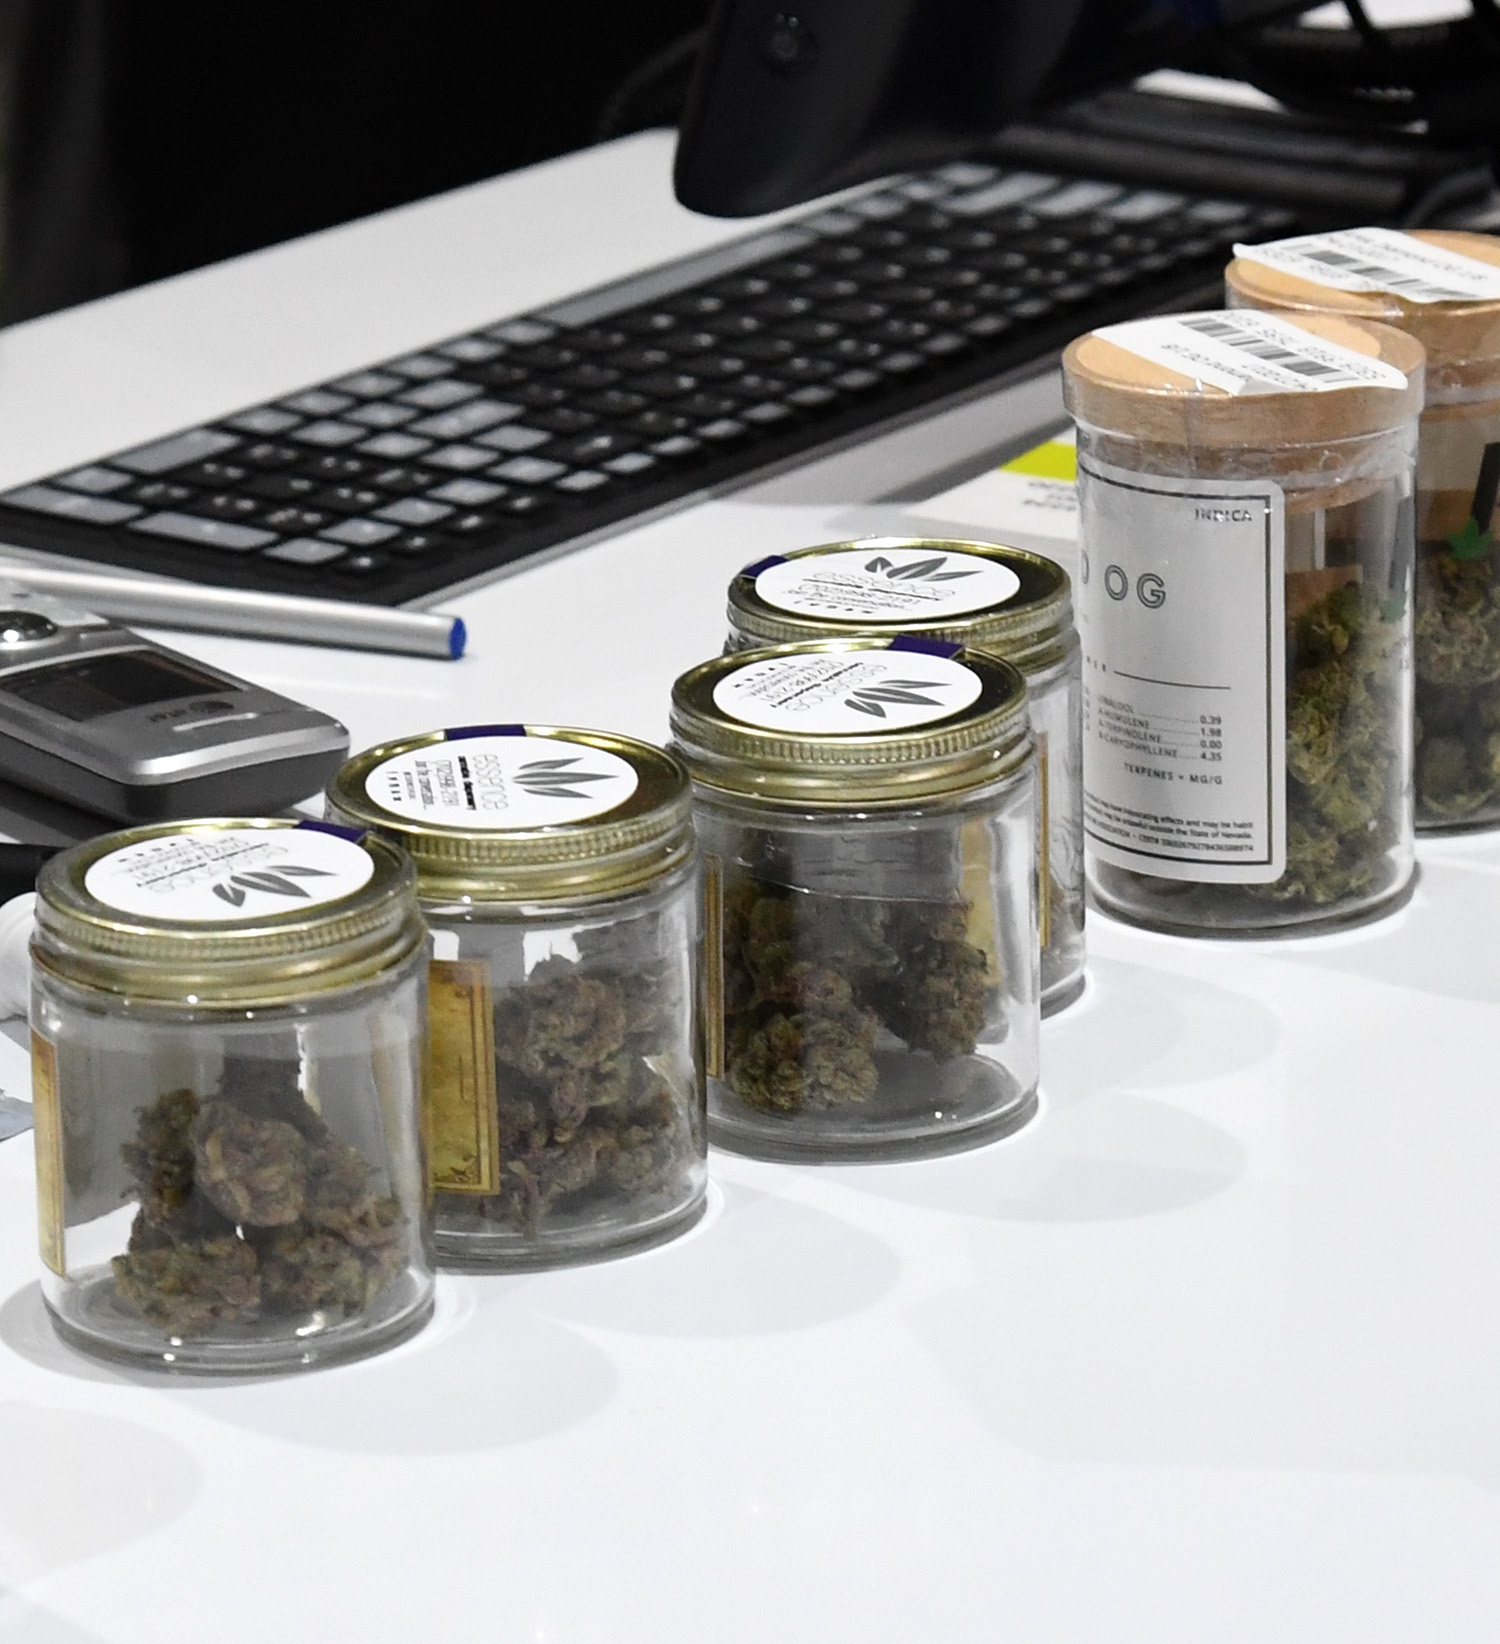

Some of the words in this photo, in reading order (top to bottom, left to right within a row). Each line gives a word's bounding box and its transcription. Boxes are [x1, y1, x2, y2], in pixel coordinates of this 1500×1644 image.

[1195, 508, 1253, 522] INDICA
[1104, 564, 1167, 609] OG
[1200, 716, 1221, 725] 0.39
[1125, 763, 1173, 780] TERPENES
